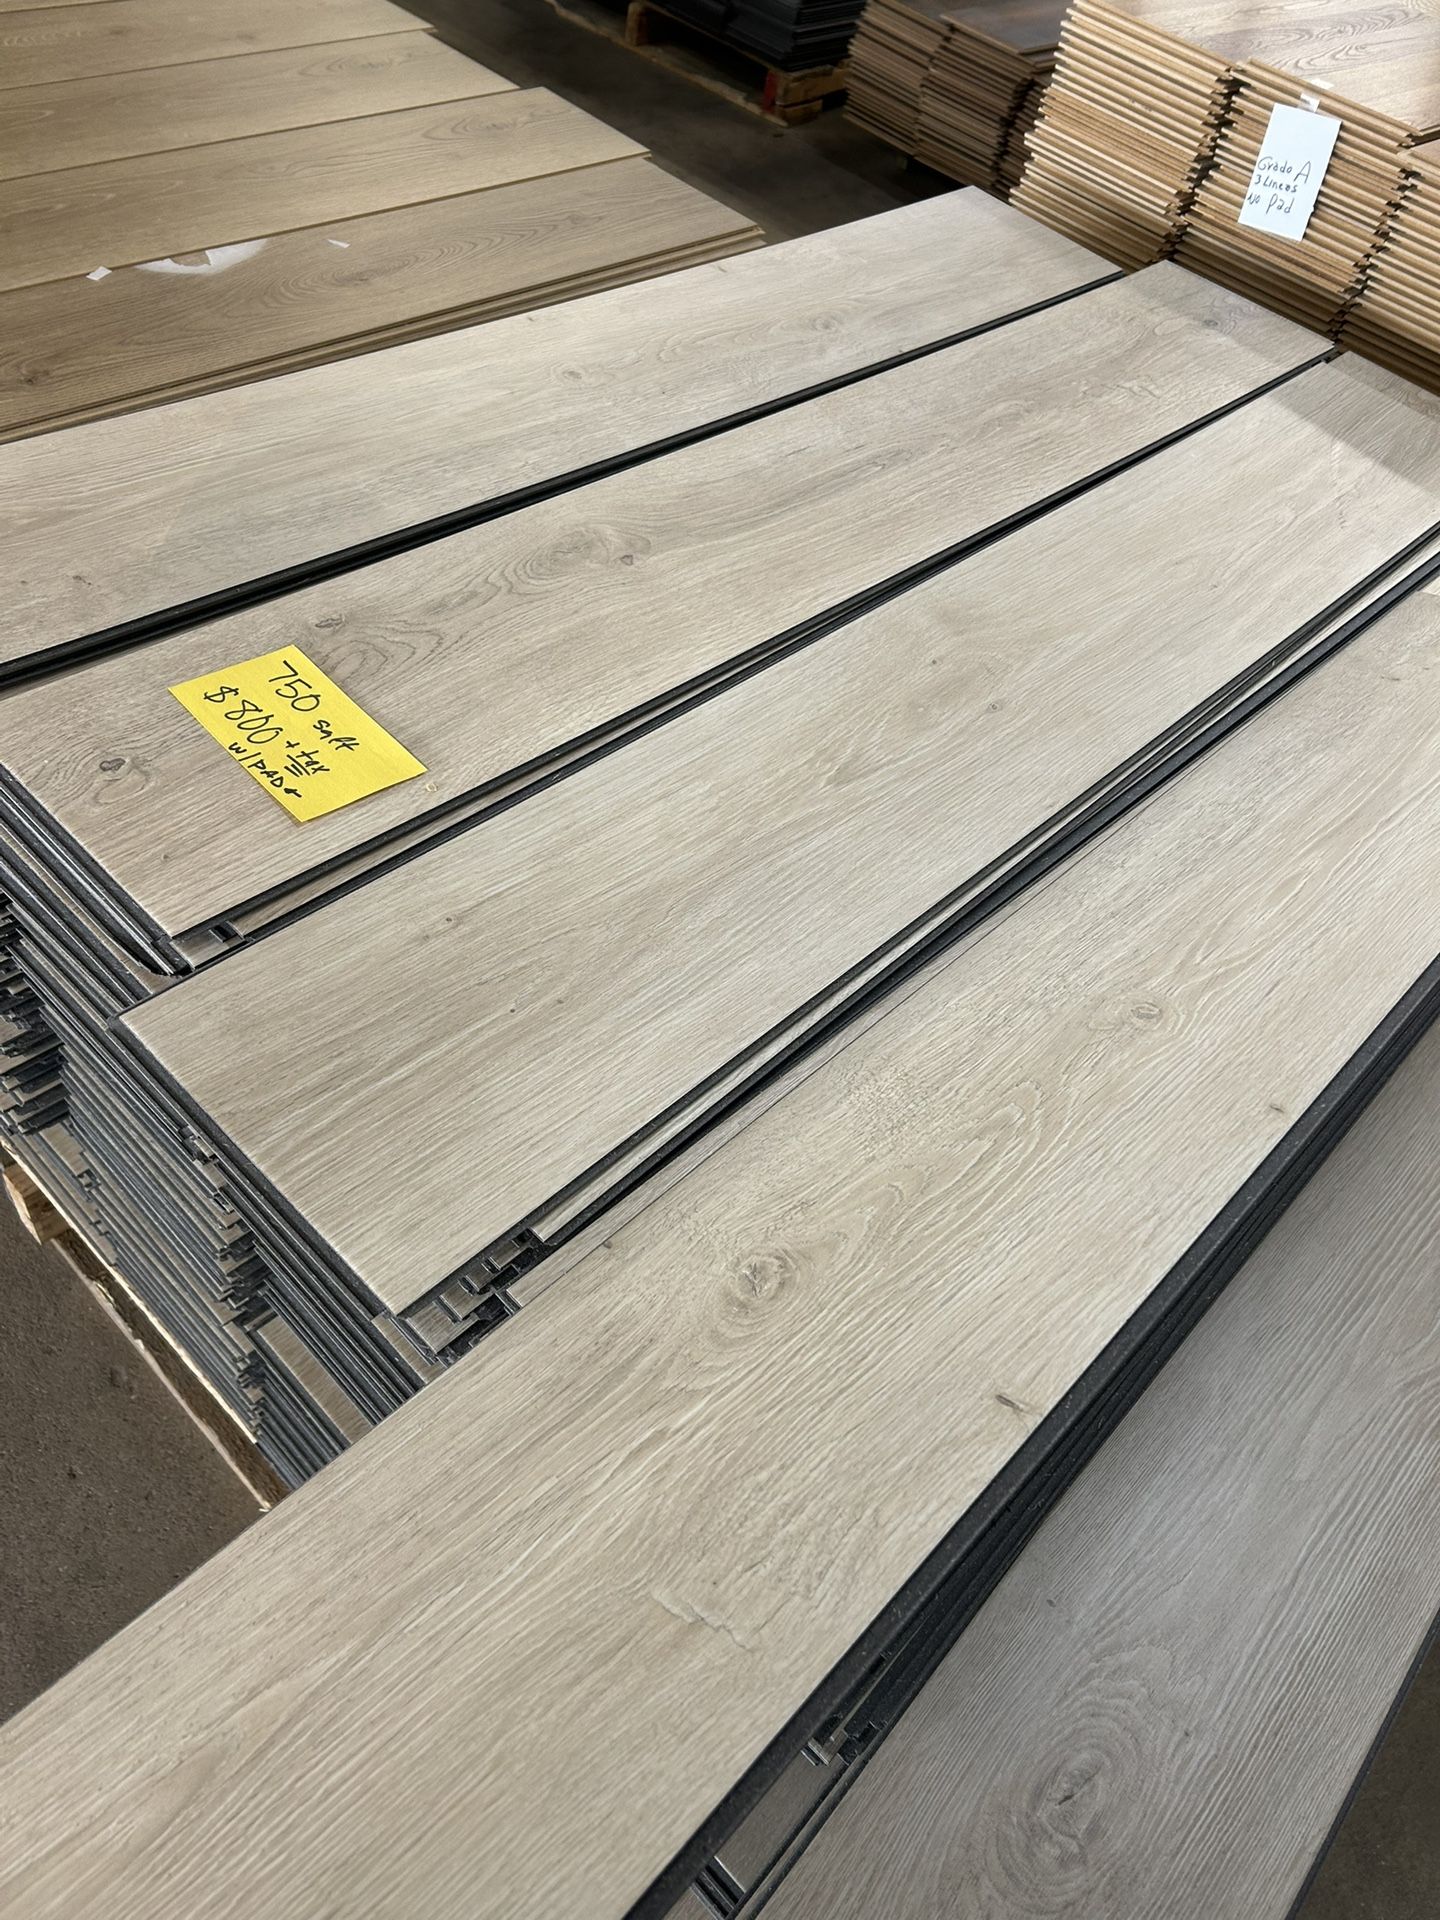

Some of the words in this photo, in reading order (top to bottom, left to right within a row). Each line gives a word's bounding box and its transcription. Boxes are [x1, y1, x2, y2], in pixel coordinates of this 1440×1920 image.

[1254, 174, 1262, 185] 3
[1293, 160, 1312, 184] A
[268, 659, 321, 712] 750
[203, 685, 284, 744] $800
[295, 750, 331, 775] tax
